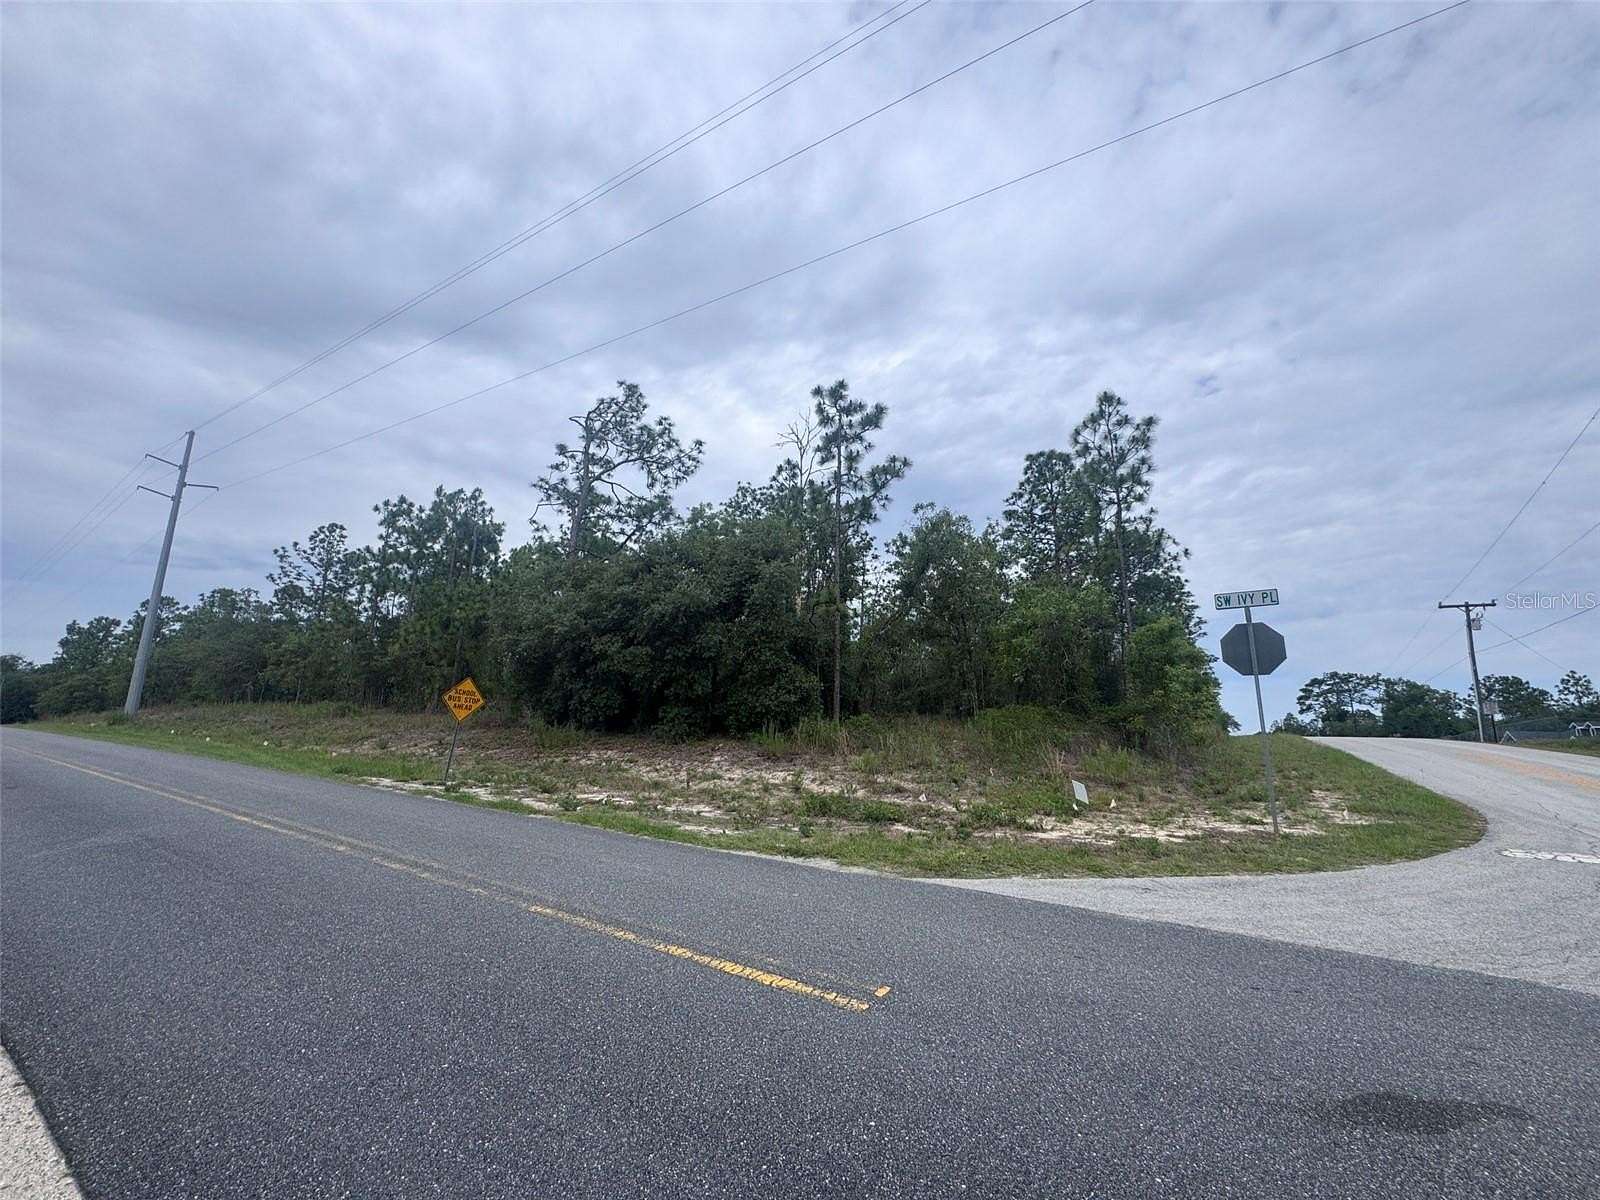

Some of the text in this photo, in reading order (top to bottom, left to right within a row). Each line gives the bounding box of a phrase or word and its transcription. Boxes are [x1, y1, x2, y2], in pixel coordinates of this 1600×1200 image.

[1217, 592, 1277, 607] SW IVY PL
[454, 689, 477, 697] SCHOOL
[453, 703, 473, 711] AHEAD
